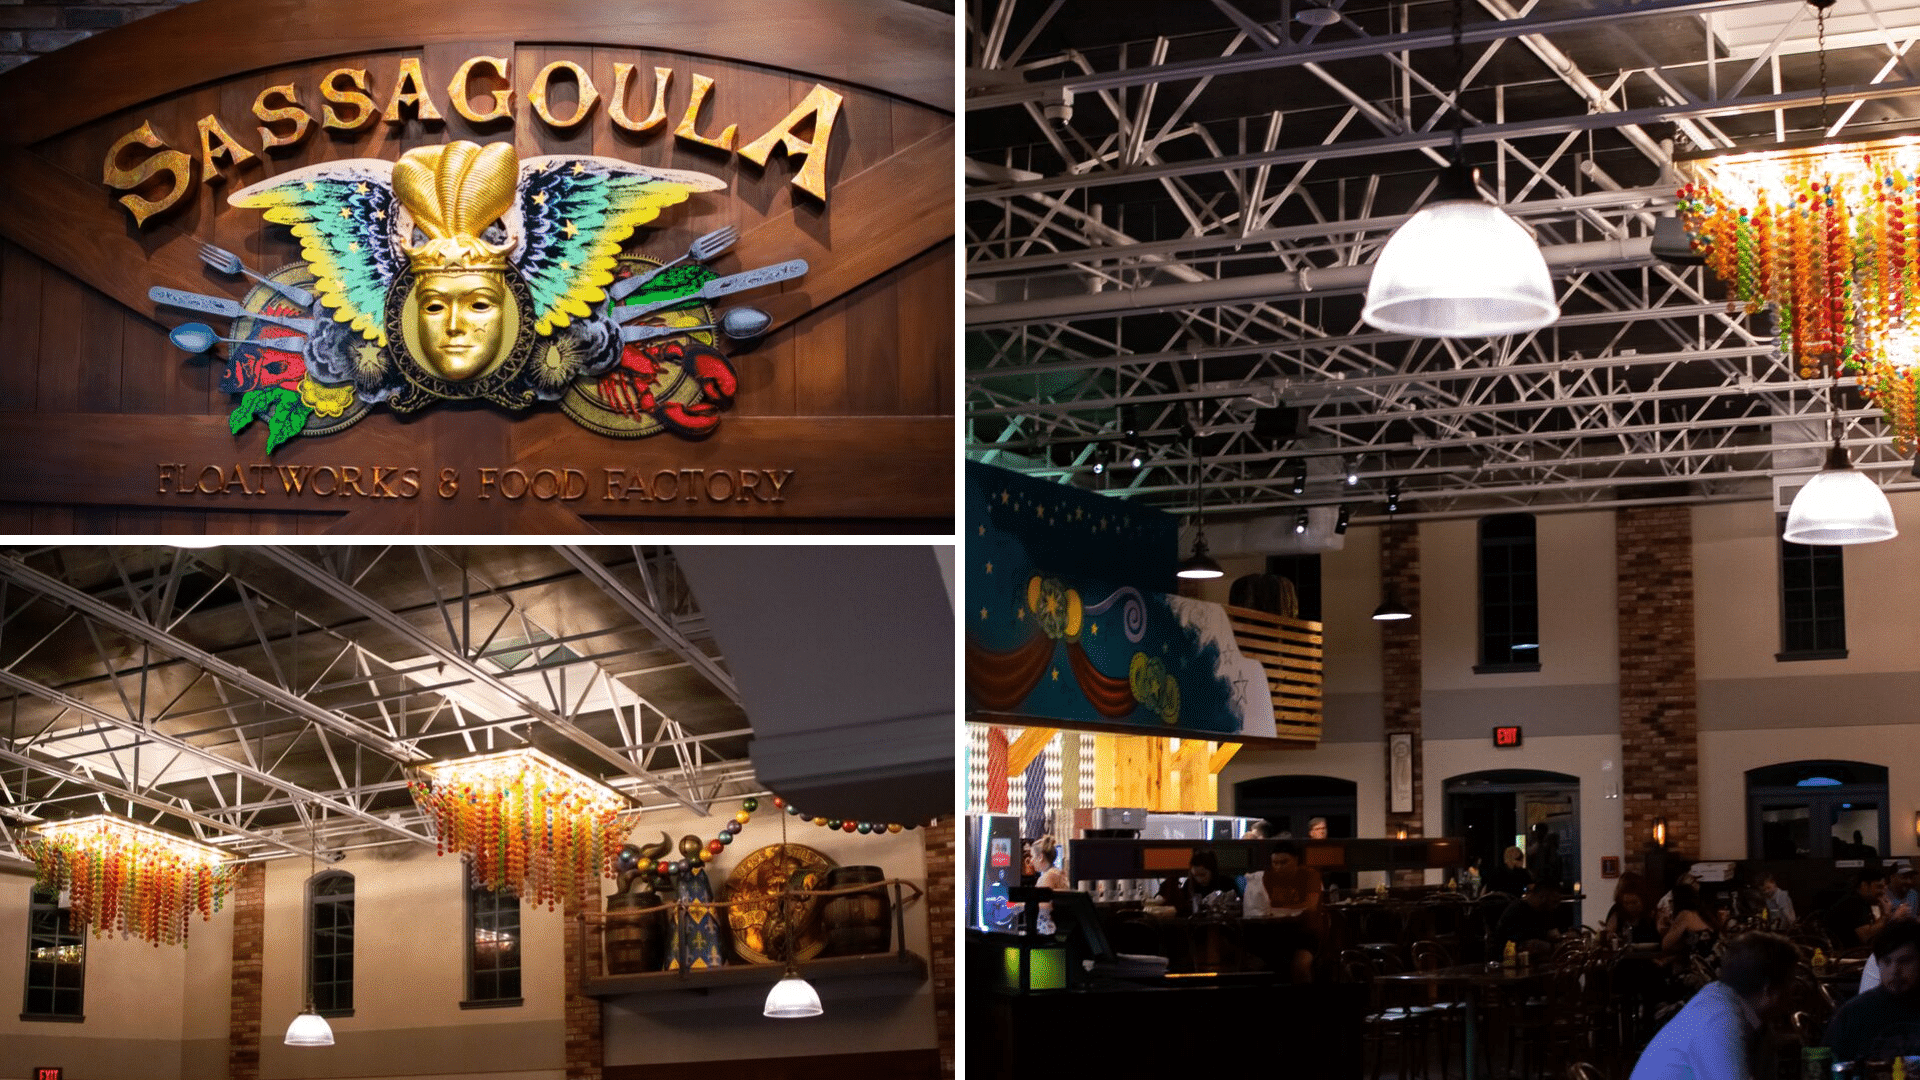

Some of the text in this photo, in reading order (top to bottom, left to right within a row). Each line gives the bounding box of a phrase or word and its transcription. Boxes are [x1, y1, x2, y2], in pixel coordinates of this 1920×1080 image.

[102, 57, 844, 228] SASSAGOULA
[156, 462, 795, 501] FLOATWORKS & FOOD FACTORY
